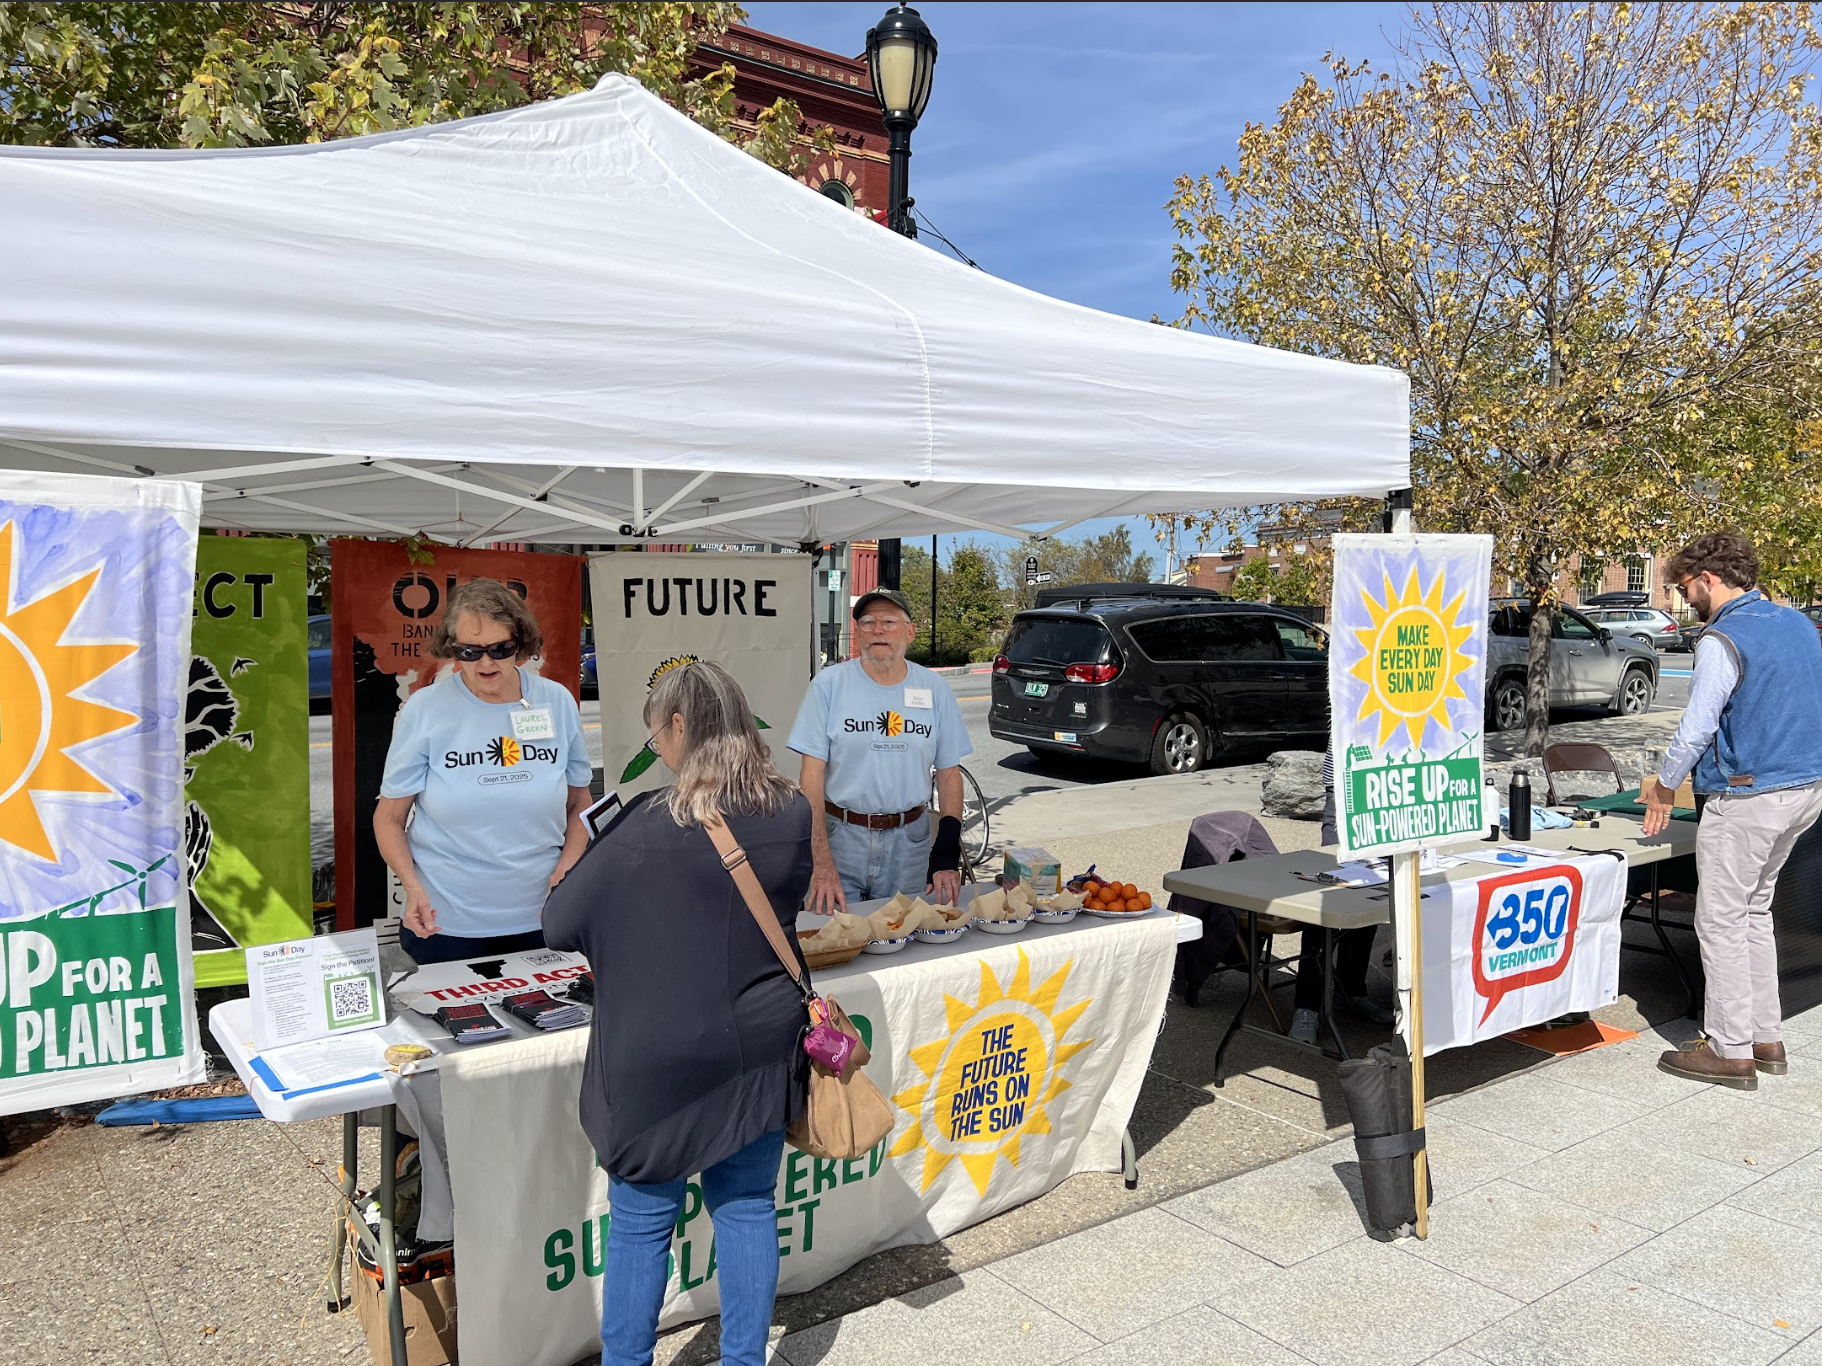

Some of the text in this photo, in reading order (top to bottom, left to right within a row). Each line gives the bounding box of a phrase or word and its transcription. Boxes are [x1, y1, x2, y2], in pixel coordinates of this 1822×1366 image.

[724, 543, 739, 552] you
[623, 577, 777, 618] FUTURE
[1397, 625, 1429, 647] MAKE
[391, 642, 421, 658] THE
[1380, 647, 1443, 670] EVERY DAY
[1388, 671, 1436, 693] SUN DAY
[515, 714, 548, 725] LAUREL
[516, 725, 548, 734] GREEN
[844, 718, 932, 738] Sun Day
[444, 744, 558, 768] Sun Day
[483, 773, 529, 784] Sept 21, 2025
[1365, 764, 1477, 810] RISE UP FOR A
[1351, 799, 1478, 849] SUN-POWERED PLANET
[1487, 885, 1569, 950] 350
[263, 946, 305, 958] Sun Day
[348, 957, 375, 966] Petition!
[1488, 942, 1558, 973] VERMONT
[62, 956, 132, 997] FOR
[141, 953, 163, 989] A
[532, 965, 588, 984] ACT
[16, 994, 168, 1074] PLANET
[982, 1023, 1014, 1055] THE
[960, 1047, 1028, 1090] FUTURE
[950, 1073, 1030, 1118] RUNS ON
[950, 1101, 1026, 1142] THE SUN
